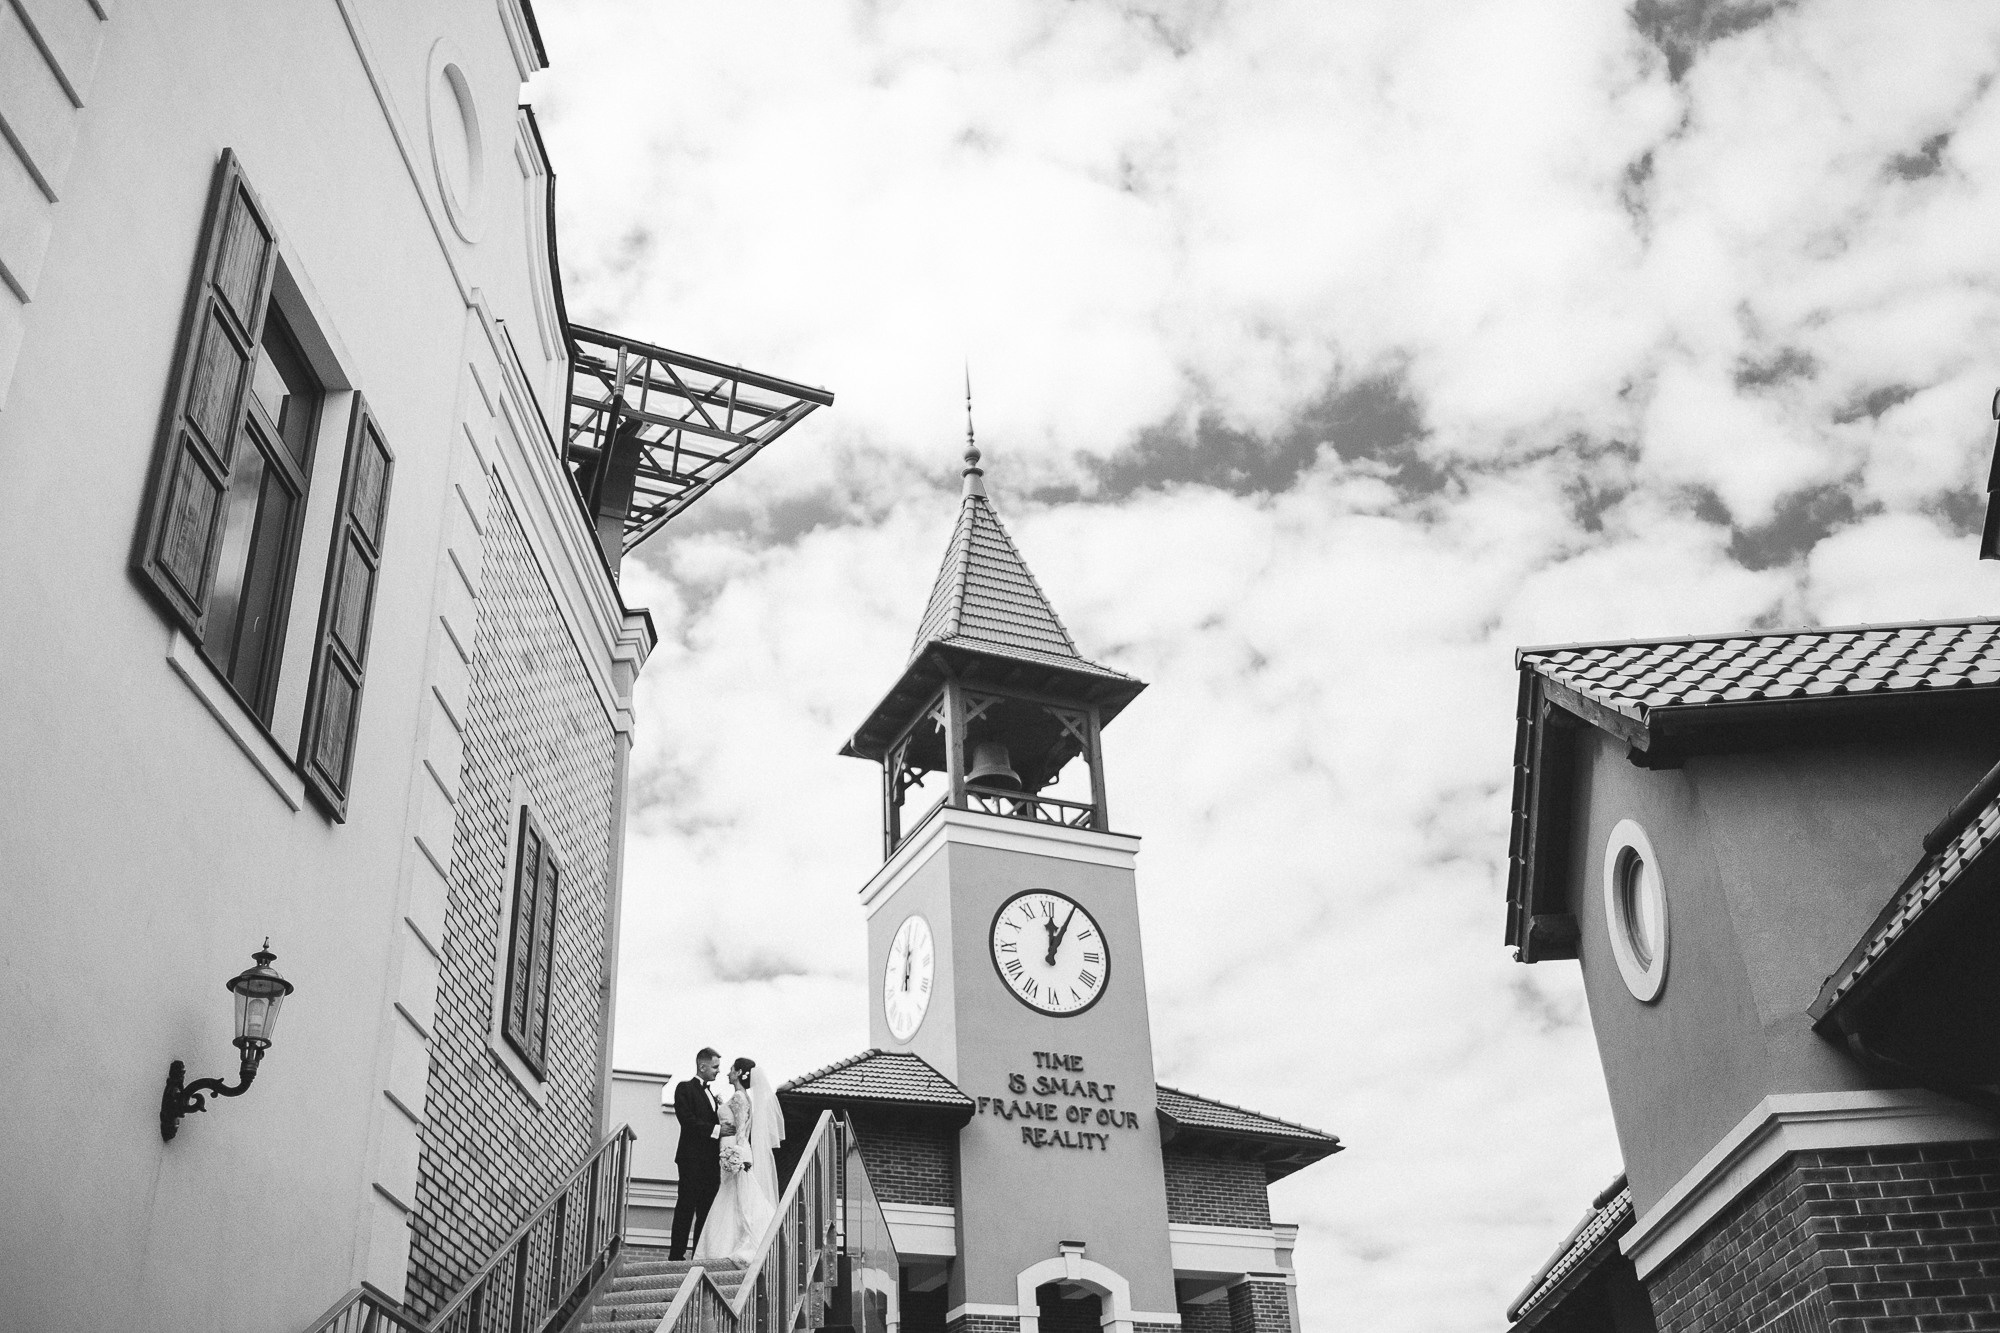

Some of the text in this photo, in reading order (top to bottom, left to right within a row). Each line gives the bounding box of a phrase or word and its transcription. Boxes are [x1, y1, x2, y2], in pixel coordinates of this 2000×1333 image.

[1019, 902, 1036, 922] XI
[1005, 918, 1021, 933] X
[1077, 929, 1092, 941] II
[1083, 952, 1099, 964] III
[1078, 969, 1097, 989] IIII
[1033, 1051, 1084, 1072] TIME
[1008, 1073, 1116, 1102] IS SMART
[977, 1096, 1139, 1129] FRAME OF OUR
[1021, 1126, 1110, 1151] REALITY
